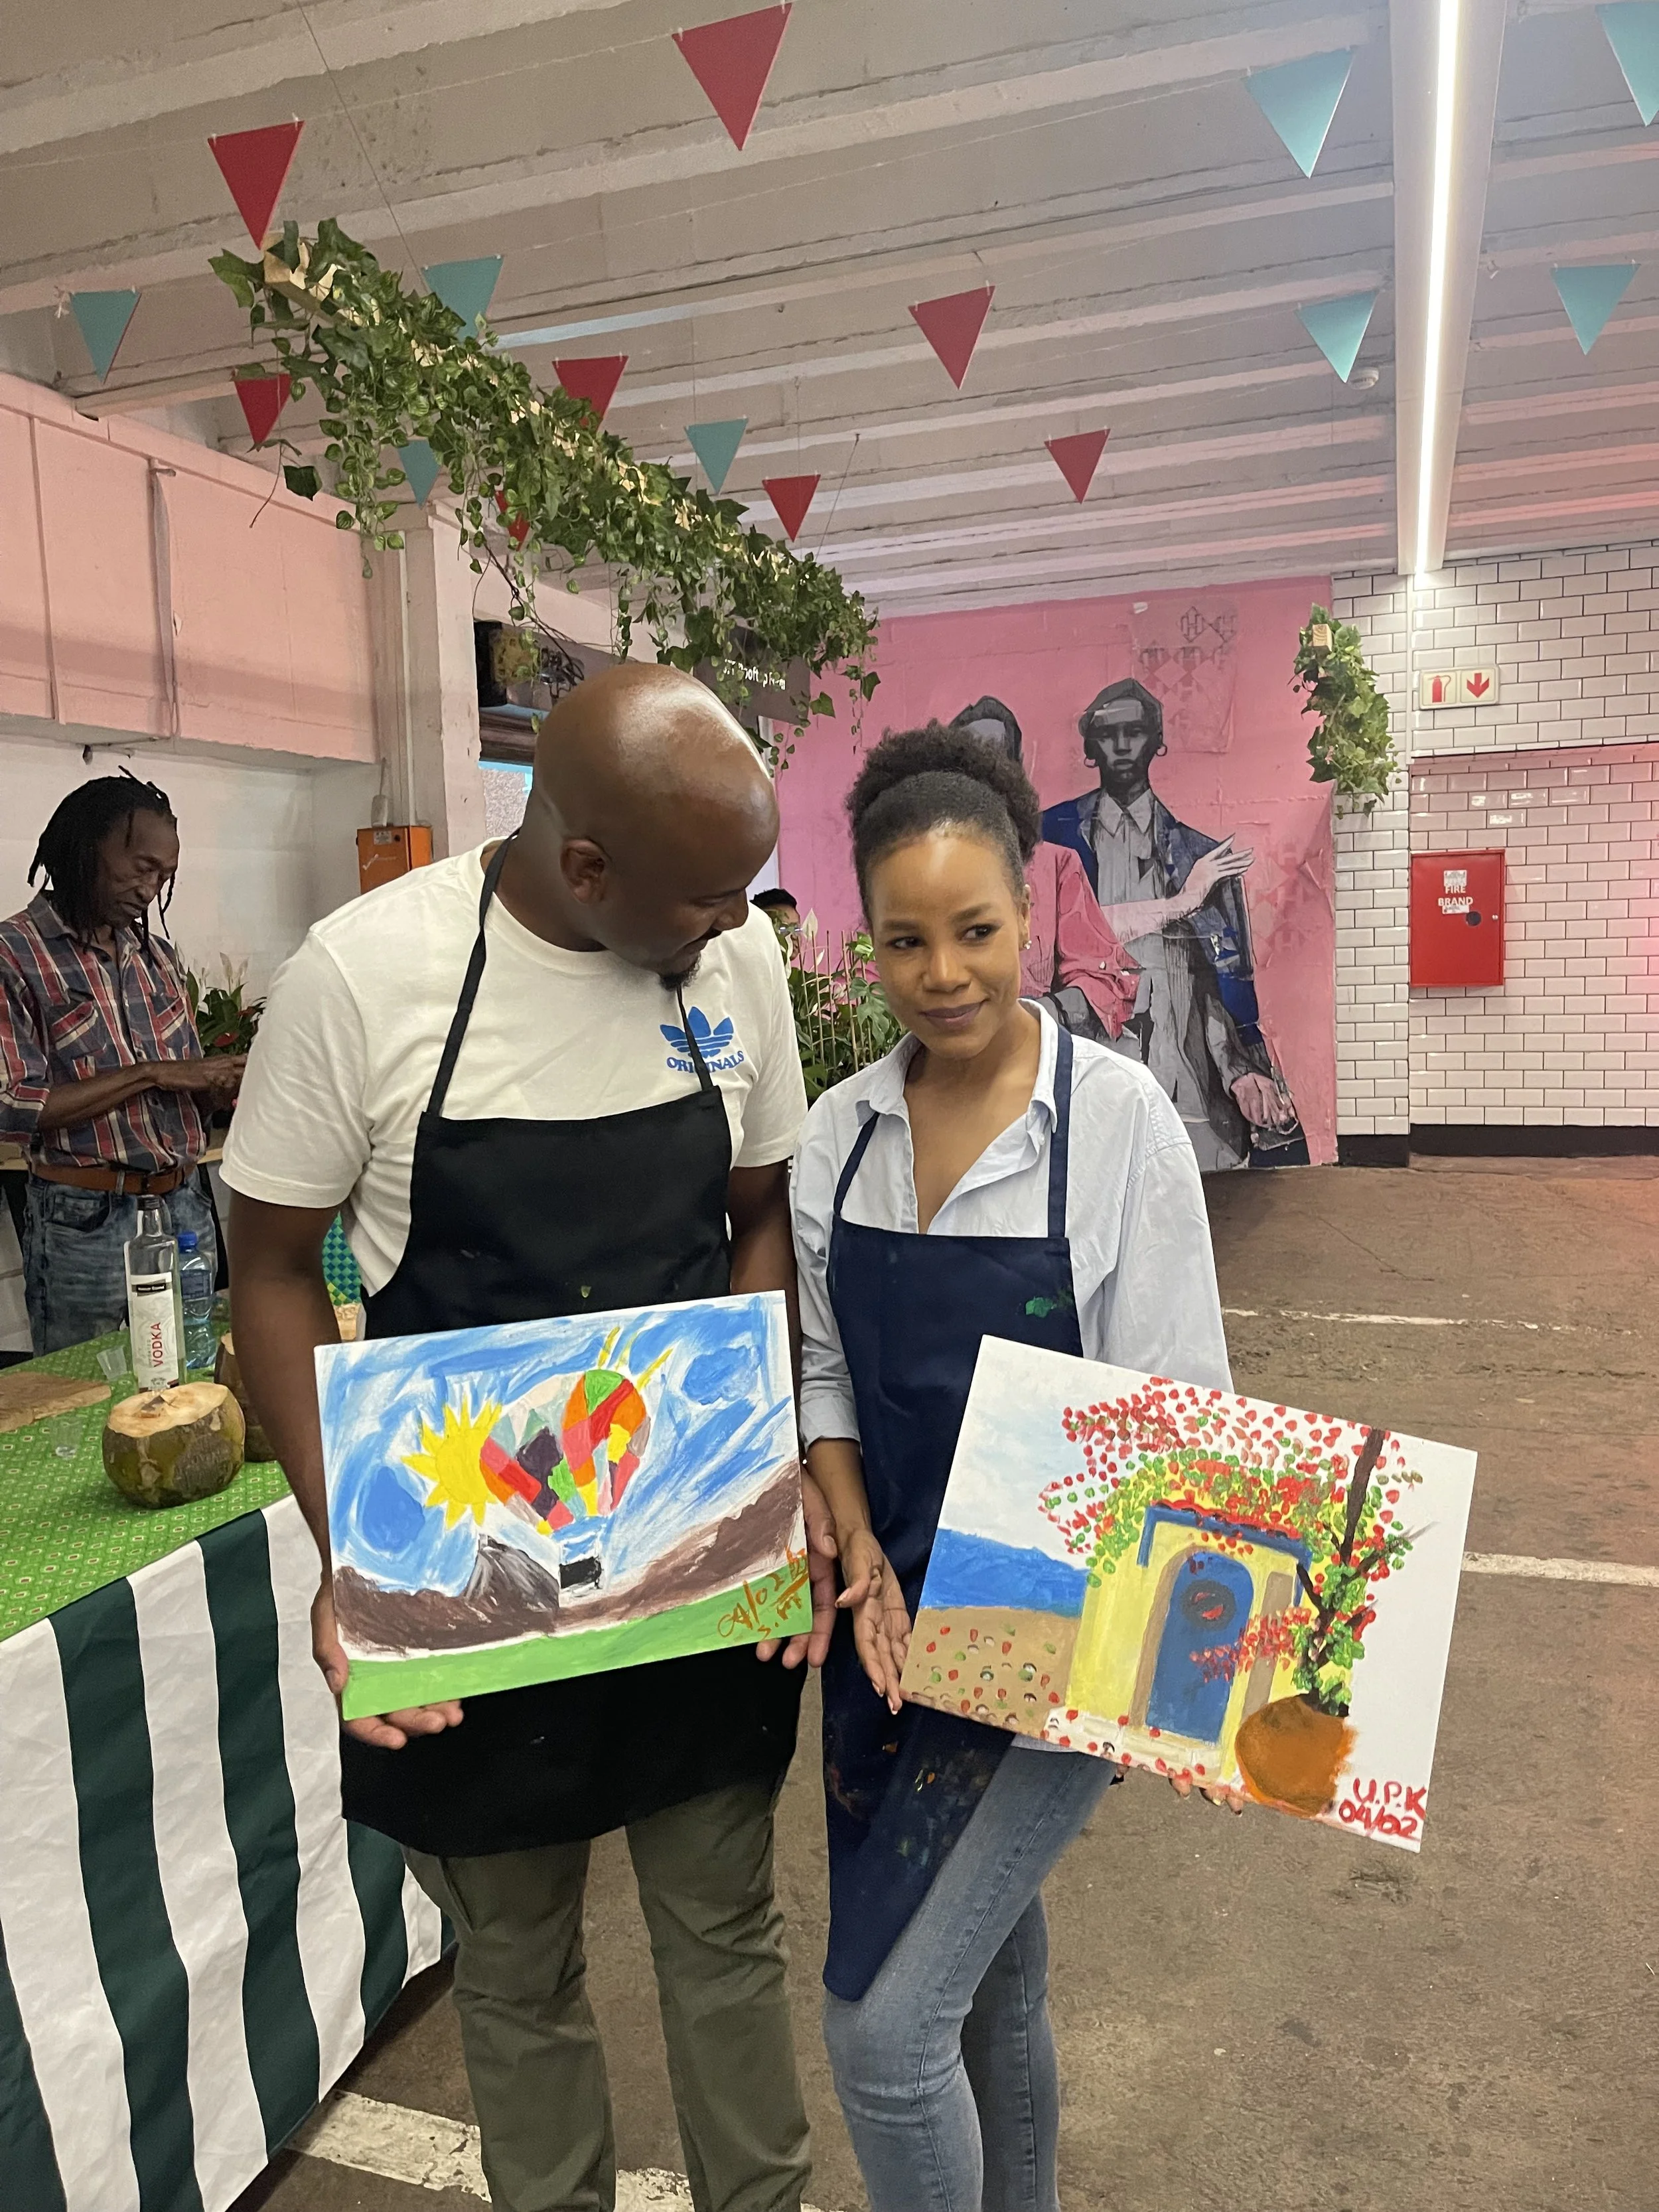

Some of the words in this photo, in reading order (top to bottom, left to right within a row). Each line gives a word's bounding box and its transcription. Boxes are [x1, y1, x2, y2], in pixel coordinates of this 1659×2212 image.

[1445, 885, 1466, 894] FIRE
[1438, 897, 1473, 907] BRAND
[666, 1051, 744, 1073] ORIINALS
[151, 1322, 163, 1367] VODKA
[1338, 1799, 1419, 1841] 04/02
